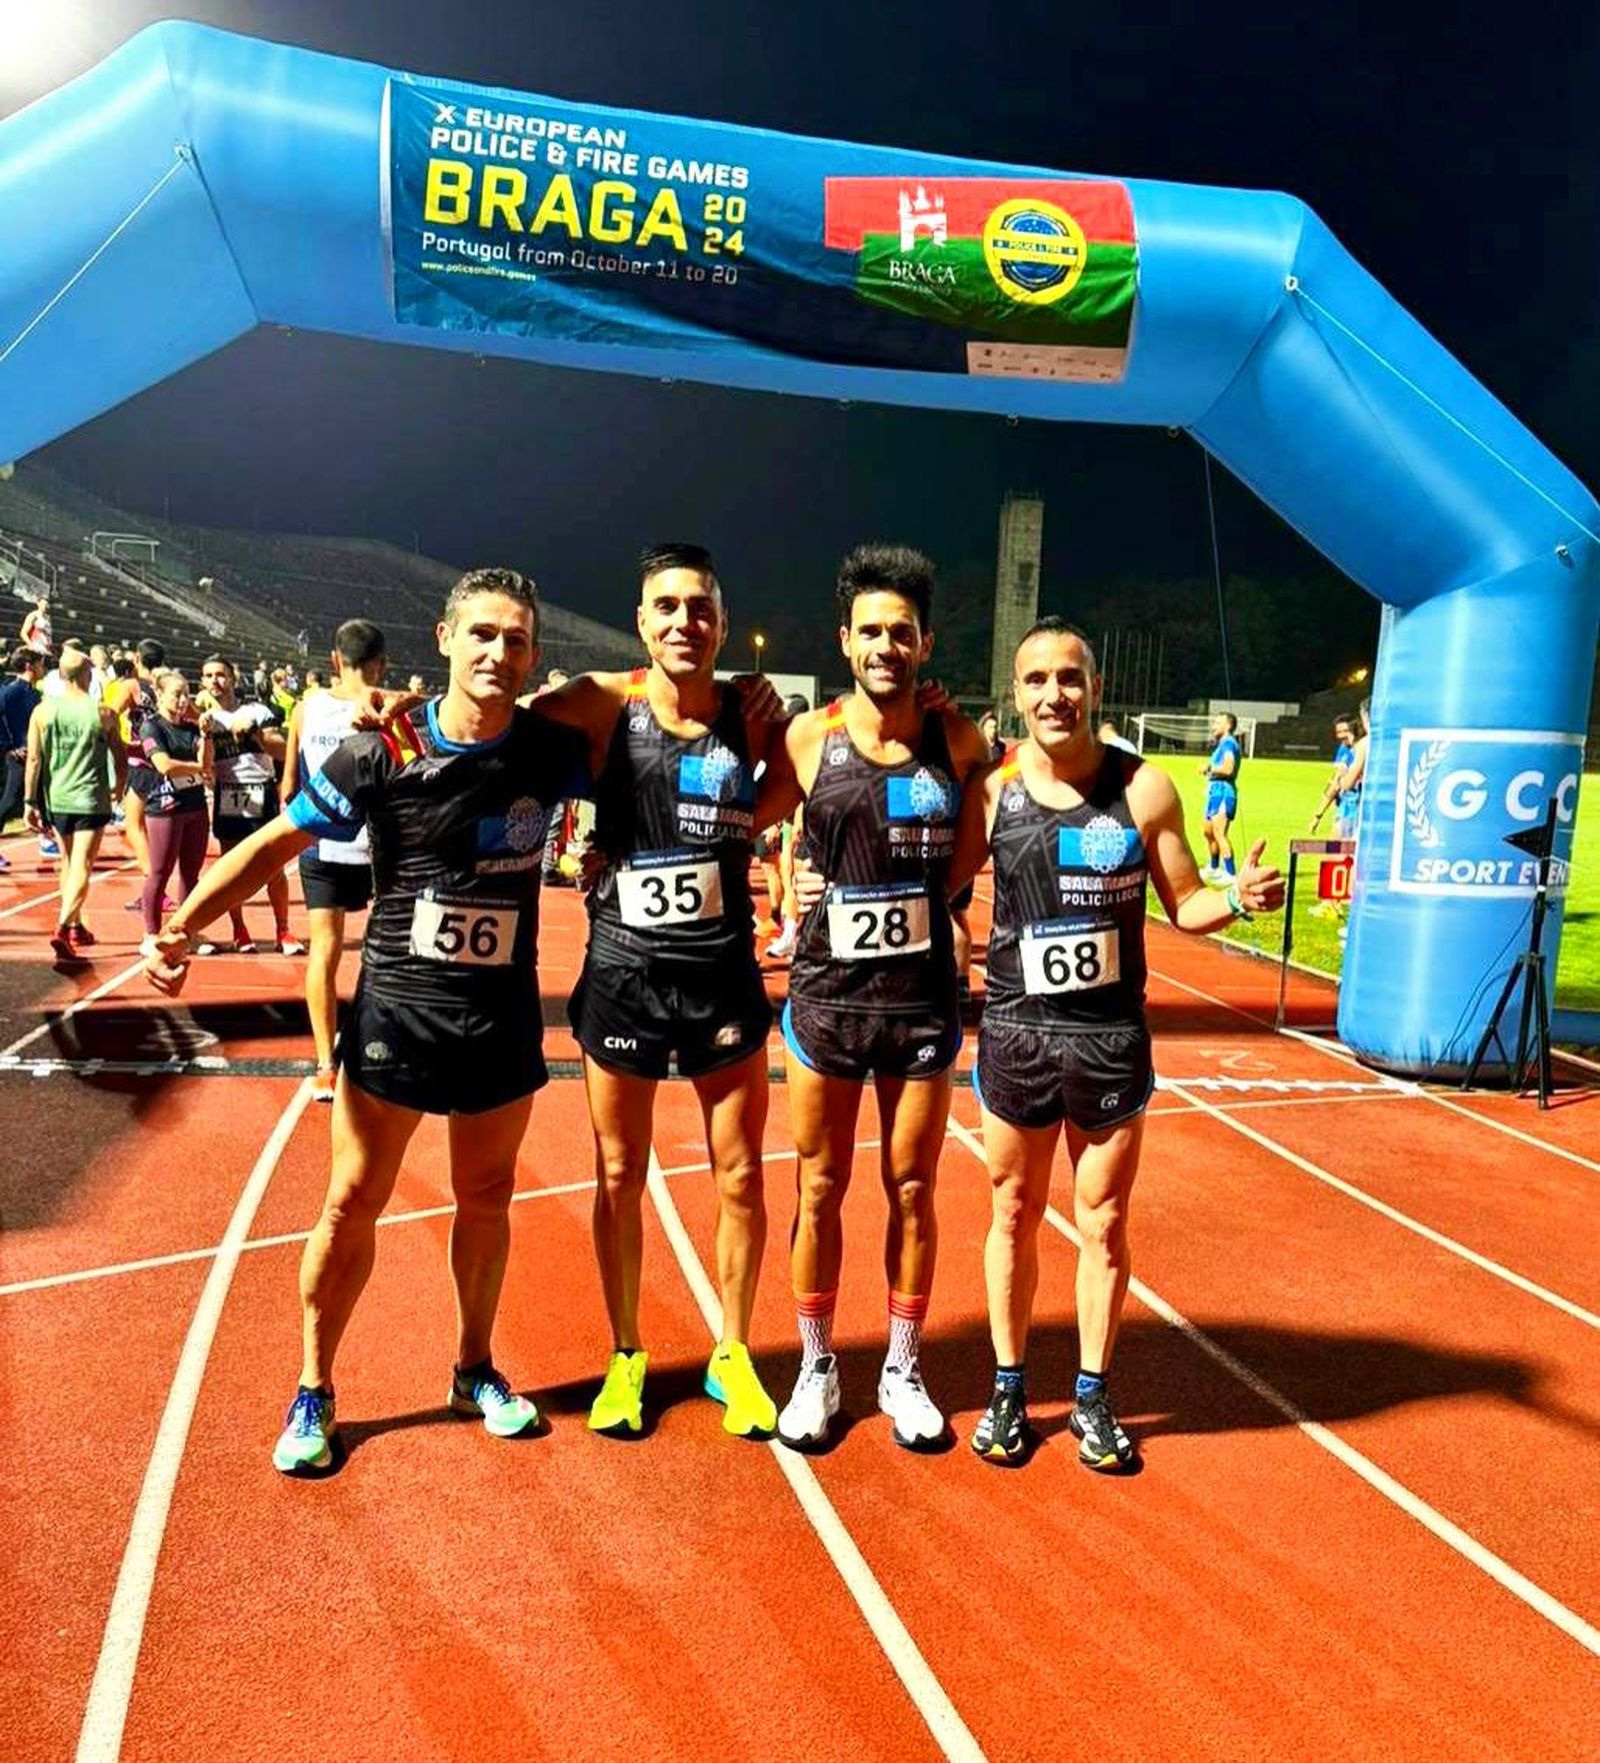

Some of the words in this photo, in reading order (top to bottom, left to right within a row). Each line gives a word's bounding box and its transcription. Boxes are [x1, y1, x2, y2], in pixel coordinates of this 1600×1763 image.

[434, 103, 456, 124] X
[465, 107, 627, 150] EUROPEAN
[430, 126, 537, 162] POLICE
[546, 143, 568, 165] &
[575, 149, 638, 176] FIRE
[646, 156, 750, 189] GAMES
[423, 157, 689, 252] BRAGA
[702, 193, 747, 225] 20
[422, 231, 512, 263] Portugal
[516, 243, 565, 266] from
[571, 249, 651, 276] October
[655, 259, 679, 280] 11
[685, 263, 706, 281] to
[711, 265, 738, 286] 20
[702, 226, 745, 257] 24
[888, 259, 956, 285] BRAGA
[311, 735, 345, 747] FRO
[230, 792, 251, 808] 17
[1414, 858, 1514, 884] SPORT
[640, 871, 703, 919] 35
[1062, 892, 1114, 907] POLICIA
[433, 912, 500, 958] 56
[852, 906, 911, 951] 28
[1042, 940, 1101, 986] 68
[603, 1036, 638, 1051] CIVI
